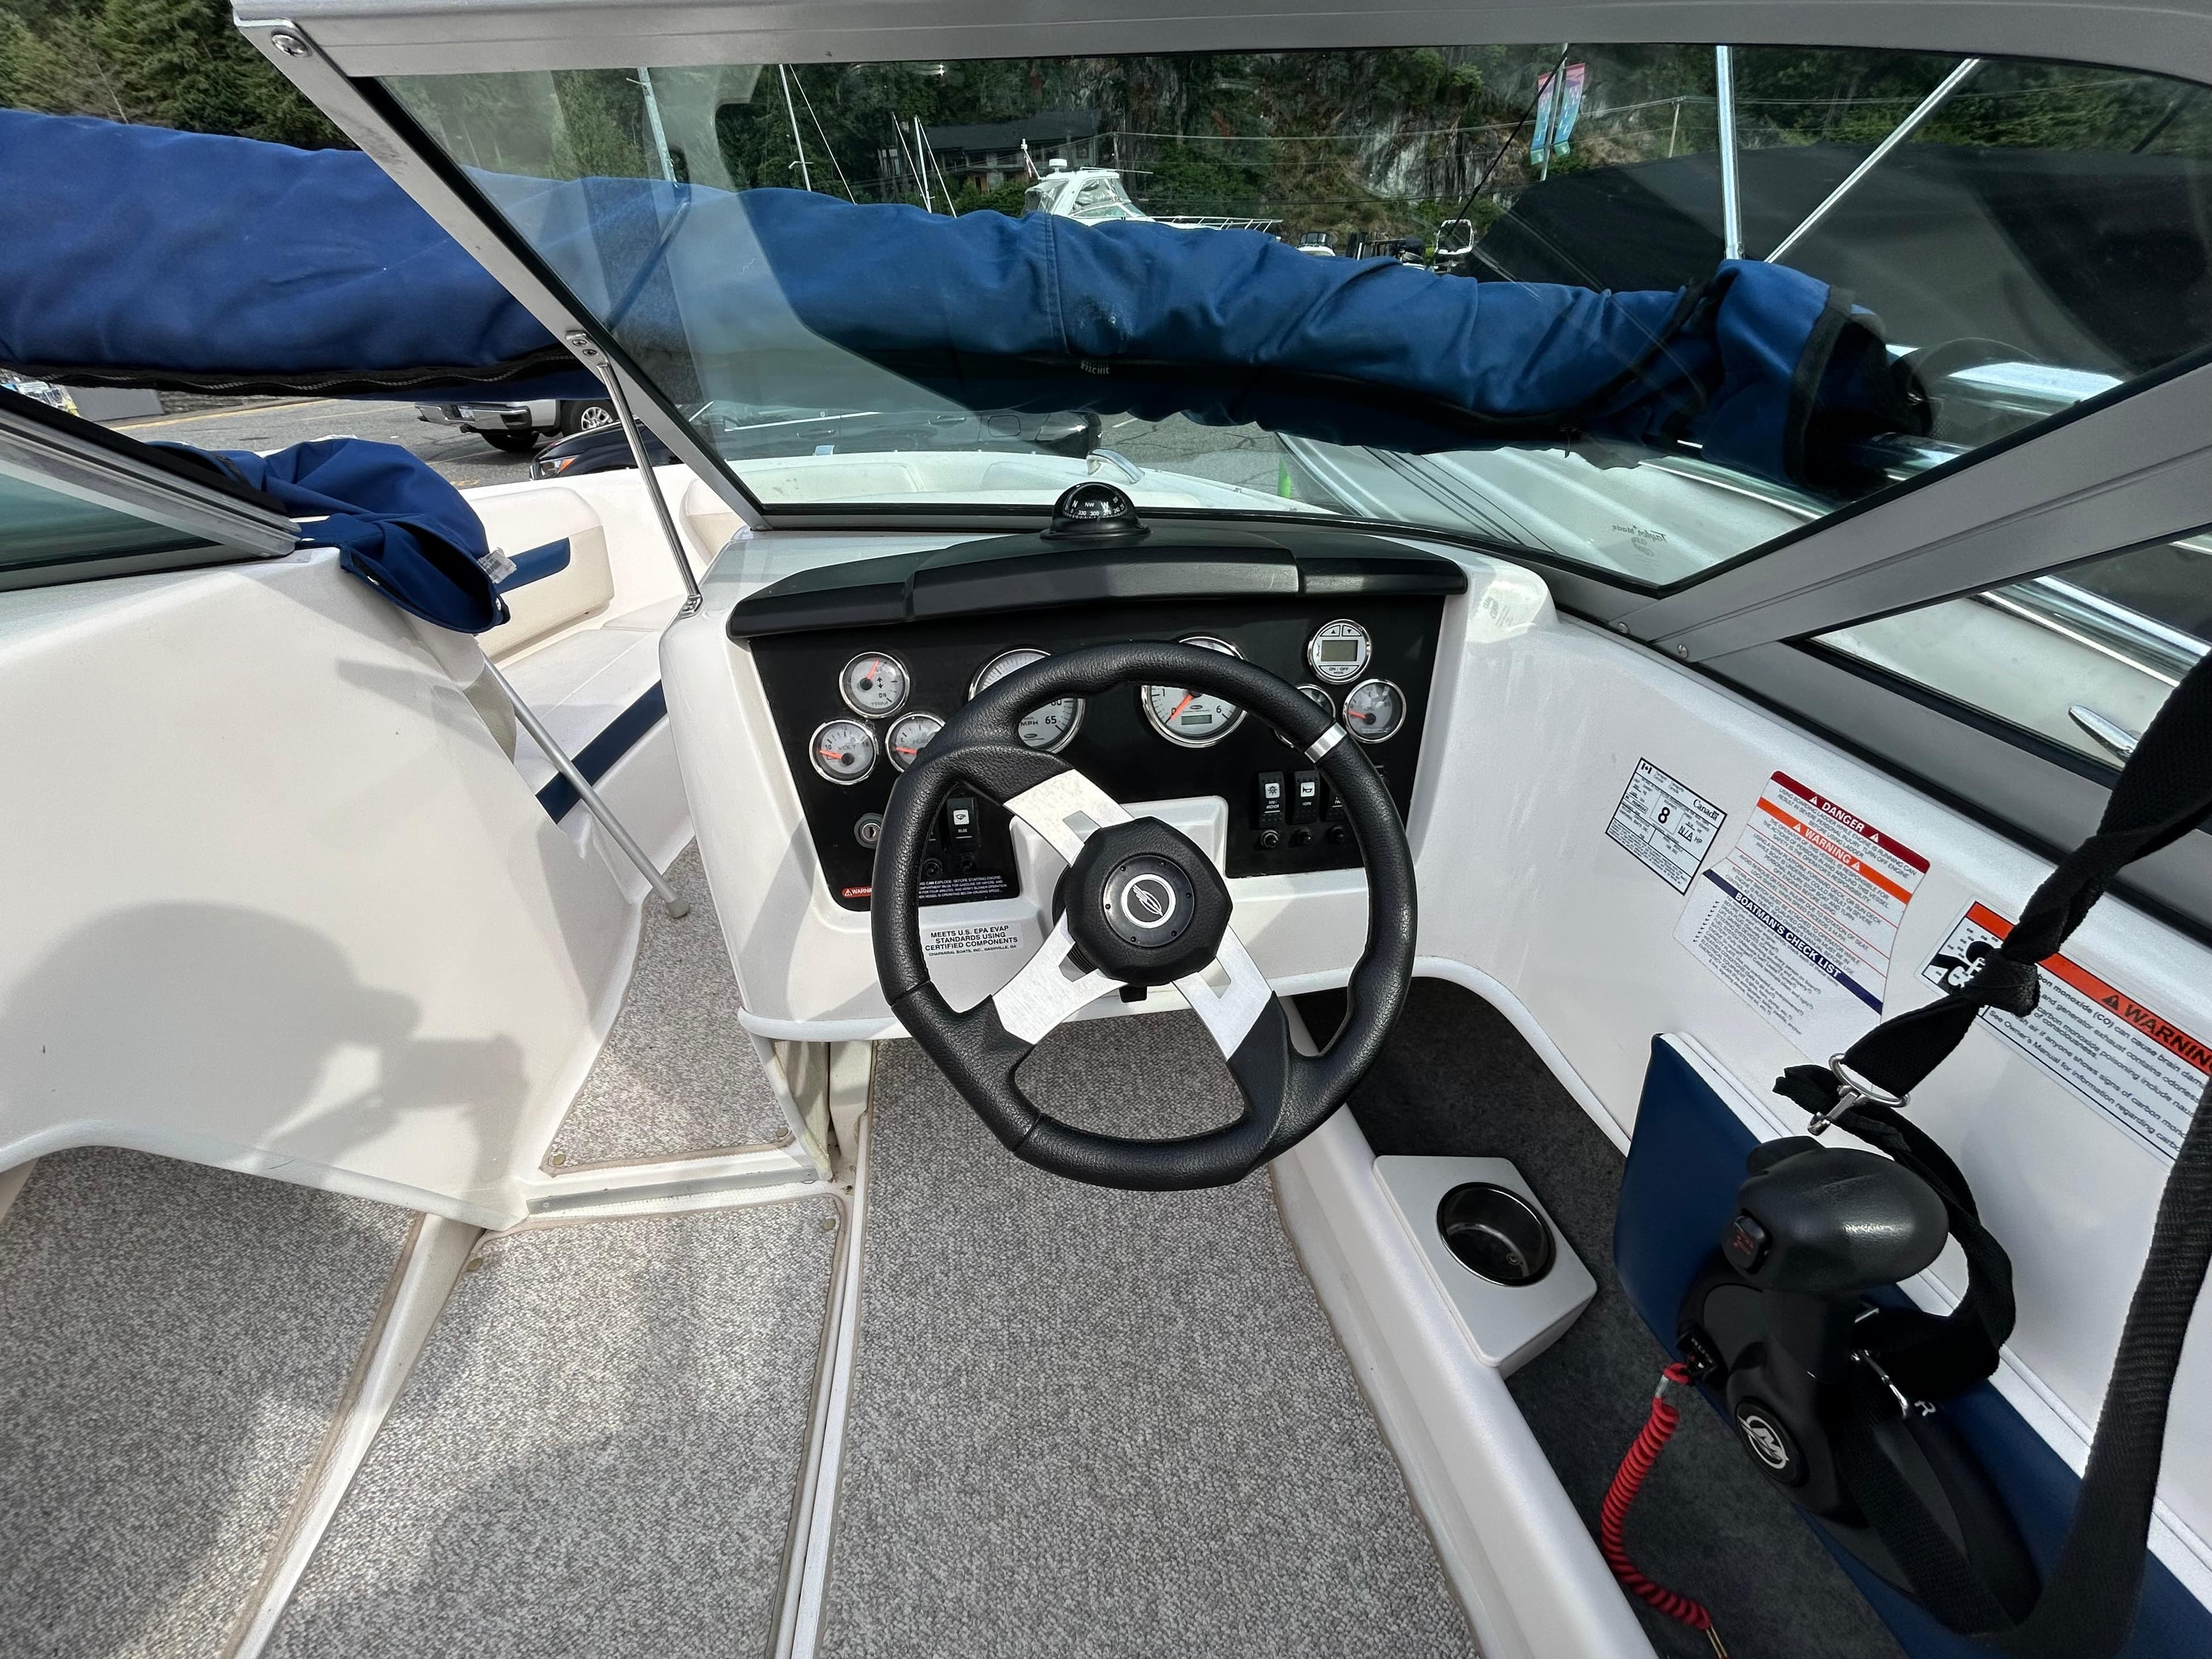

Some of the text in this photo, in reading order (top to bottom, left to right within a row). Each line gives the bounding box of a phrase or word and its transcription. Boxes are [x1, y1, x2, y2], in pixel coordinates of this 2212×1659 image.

[1071, 500, 1078, 508] N
[1162, 688, 1165, 696] 1
[1217, 705, 1221, 713] 6
[1045, 715, 1056, 724] 65
[1658, 806, 1671, 824] 8
[1691, 797, 1719, 821] Canada
[1821, 801, 1865, 833] DANGER
[1678, 825, 1694, 840] N/A
[1804, 828, 1851, 865] WARNING
[925, 937, 1018, 950] CERTIFIED COMPONENTS
[935, 935, 980, 944] STANDARDS
[1734, 892, 1841, 979] BOATMAN'S CHECK LIST
[2040, 993, 2057, 1006] and
[2055, 1003, 2093, 1032] generator
[2093, 1028, 2126, 1054] exhaust
[2125, 1050, 2162, 1078] contains
[2052, 984, 2093, 1014] monoxide
[2092, 1010, 2115, 1029] (CO)
[2113, 1024, 2130, 1039] can
[2130, 1036, 2157, 1058] cause
[2157, 1052, 2181, 1073] brain
